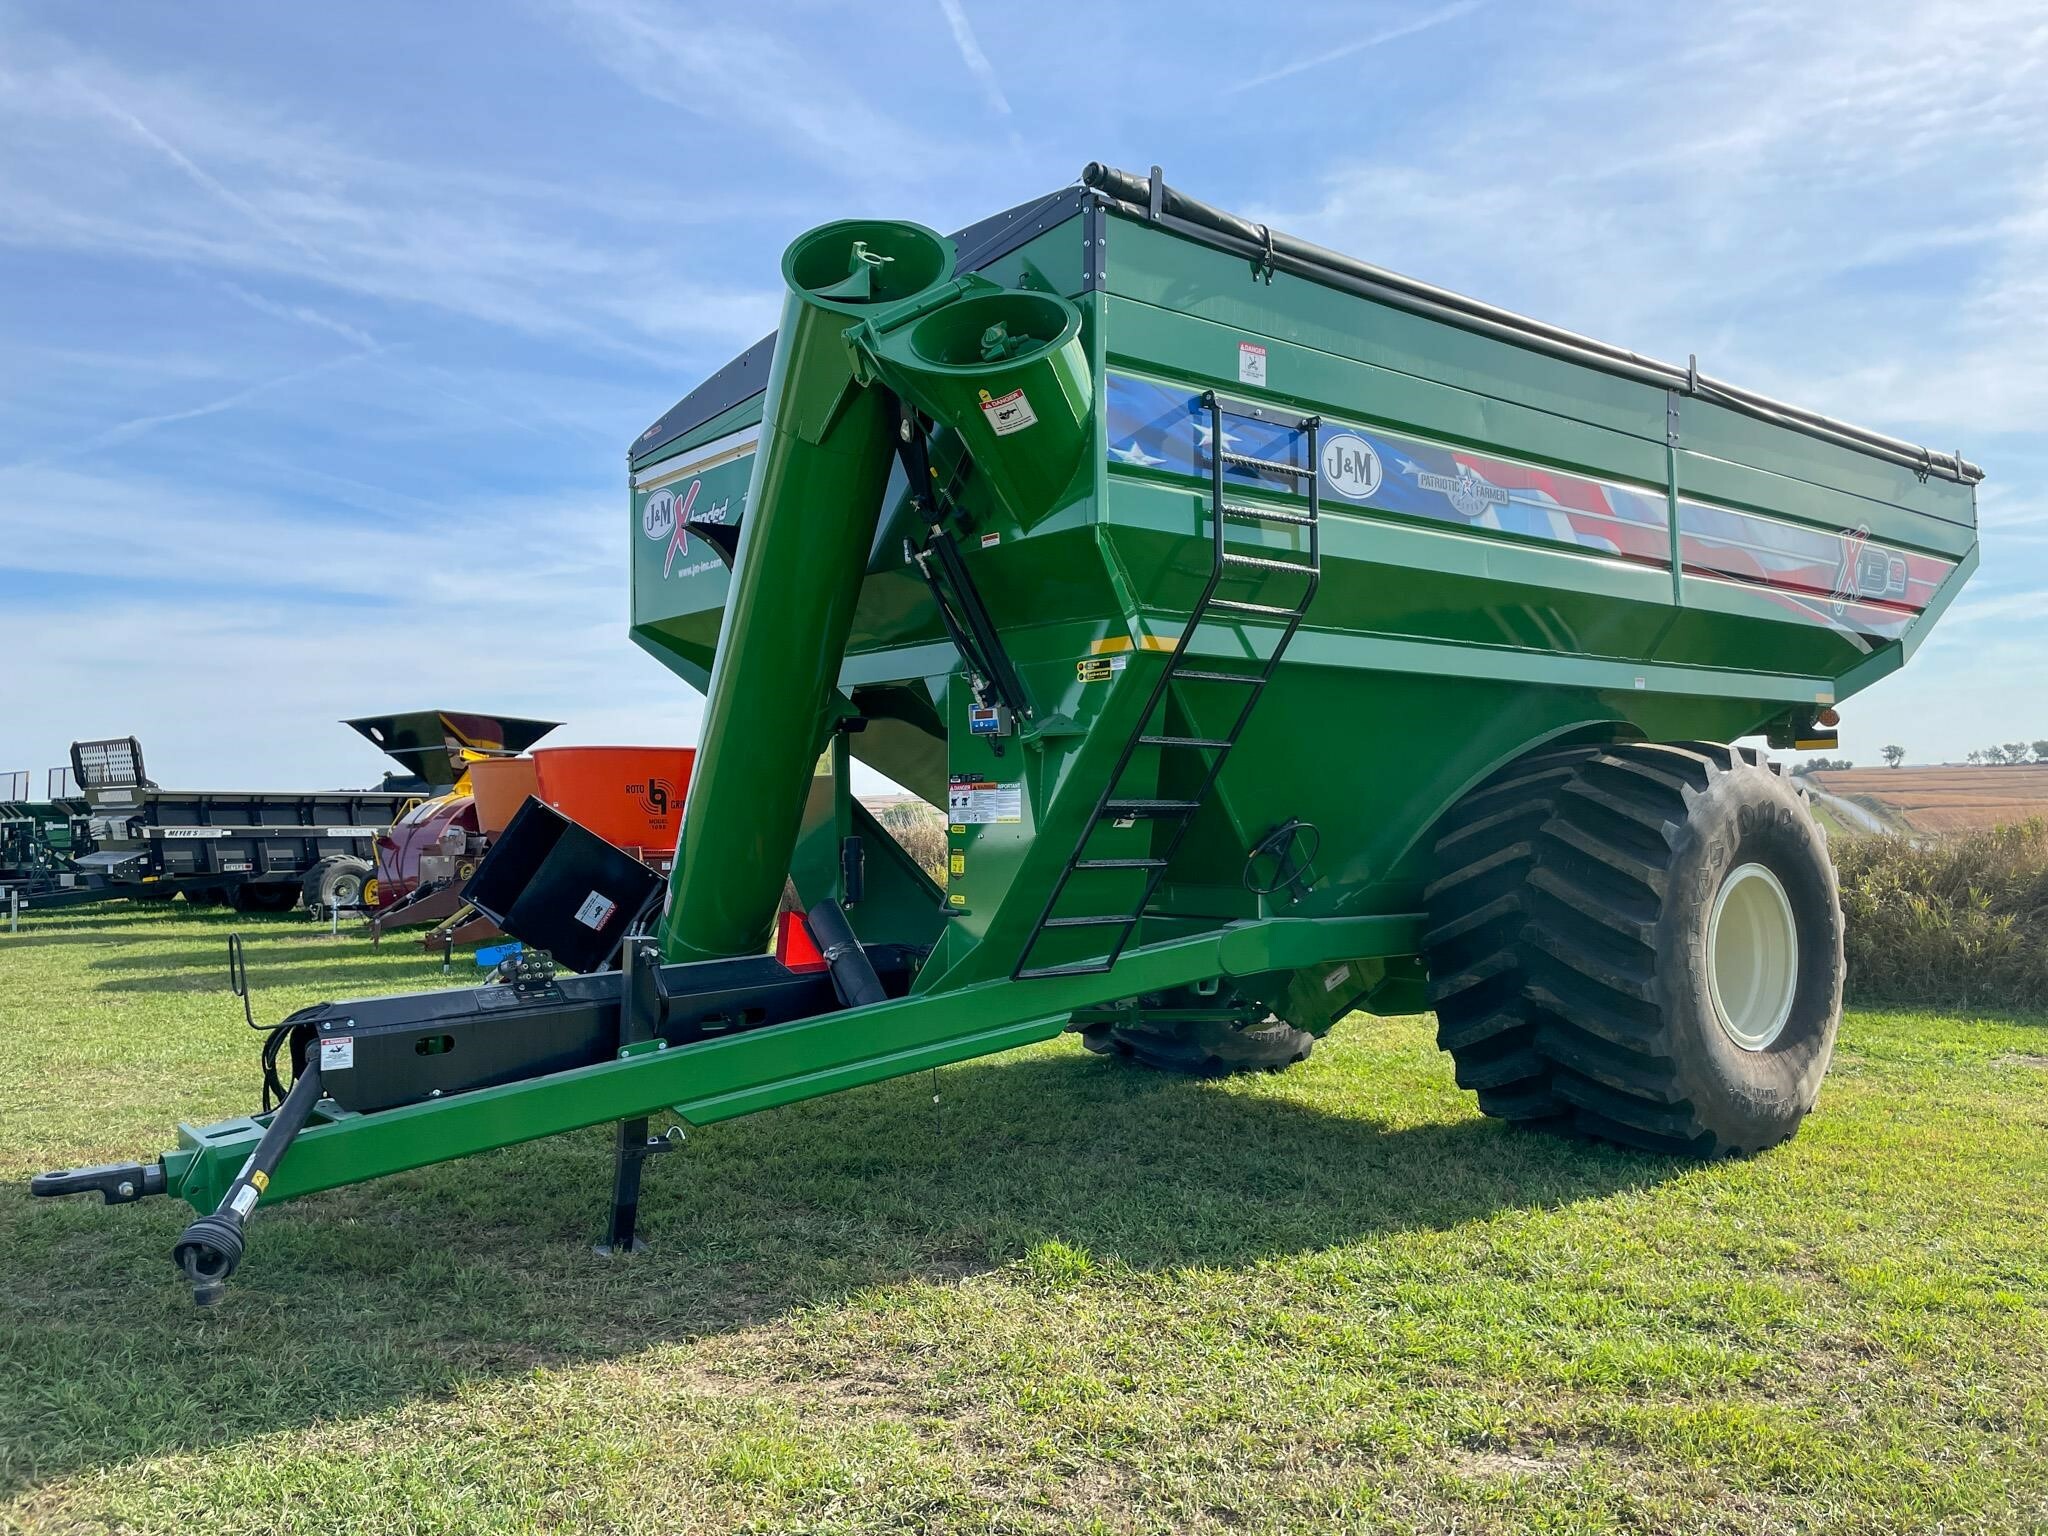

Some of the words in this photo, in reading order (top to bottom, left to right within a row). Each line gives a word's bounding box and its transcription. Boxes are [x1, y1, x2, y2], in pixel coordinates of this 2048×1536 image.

[1243, 344, 1266, 356] DANGER
[991, 392, 1019, 408] DANGER
[1327, 446, 1372, 487] J&M
[1420, 474, 1460, 493] PATRIOTIC
[1476, 485, 1506, 502] FARMER
[646, 498, 672, 531] J&M
[625, 785, 645, 794] ROTO
